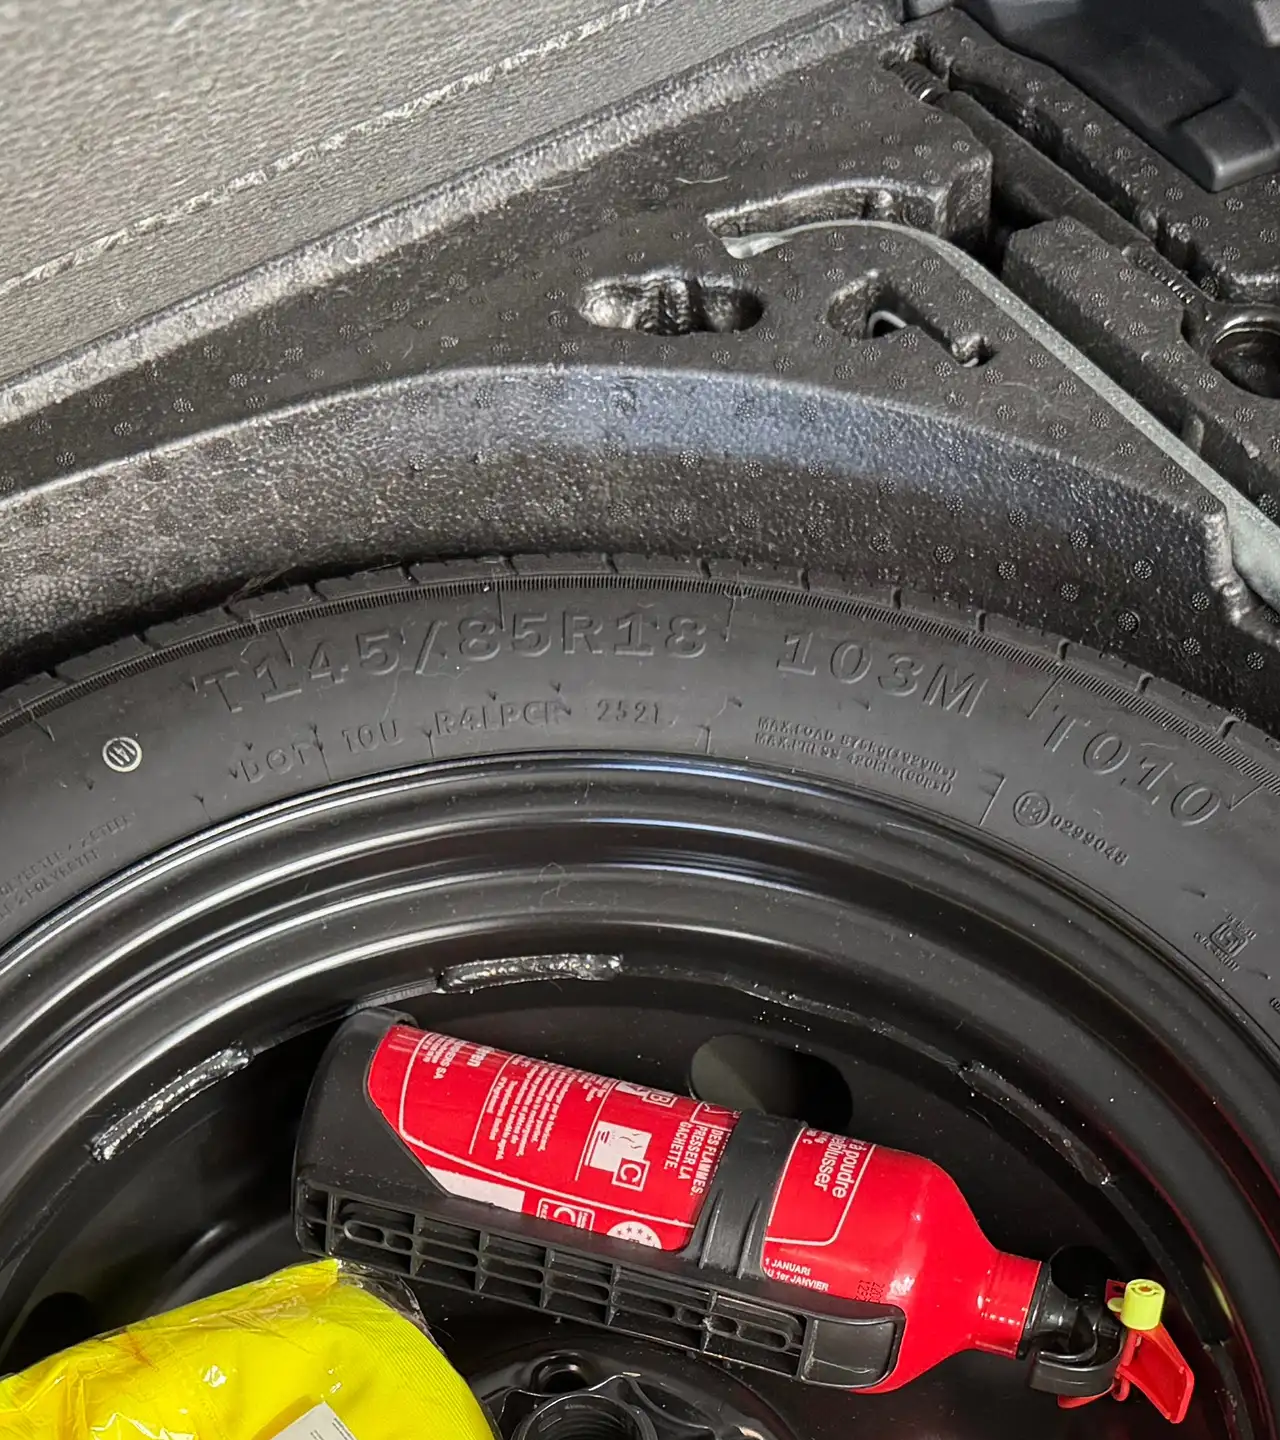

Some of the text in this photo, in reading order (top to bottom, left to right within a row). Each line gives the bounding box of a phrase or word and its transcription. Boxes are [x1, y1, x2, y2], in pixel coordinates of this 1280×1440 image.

[203, 610, 708, 714] T145/85R18
[776, 630, 990, 717] 103M
[663, 1120, 691, 1172] GACHETTE.
[677, 1124, 706, 1181] PRESSER LA
[690, 1127, 723, 1198] DES FLAMMES.
[617, 1160, 643, 1184] C
[831, 1149, 861, 1200] poudre
[771, 1258, 811, 1276] JANUARI
[789, 1274, 830, 1291] JANVIER
